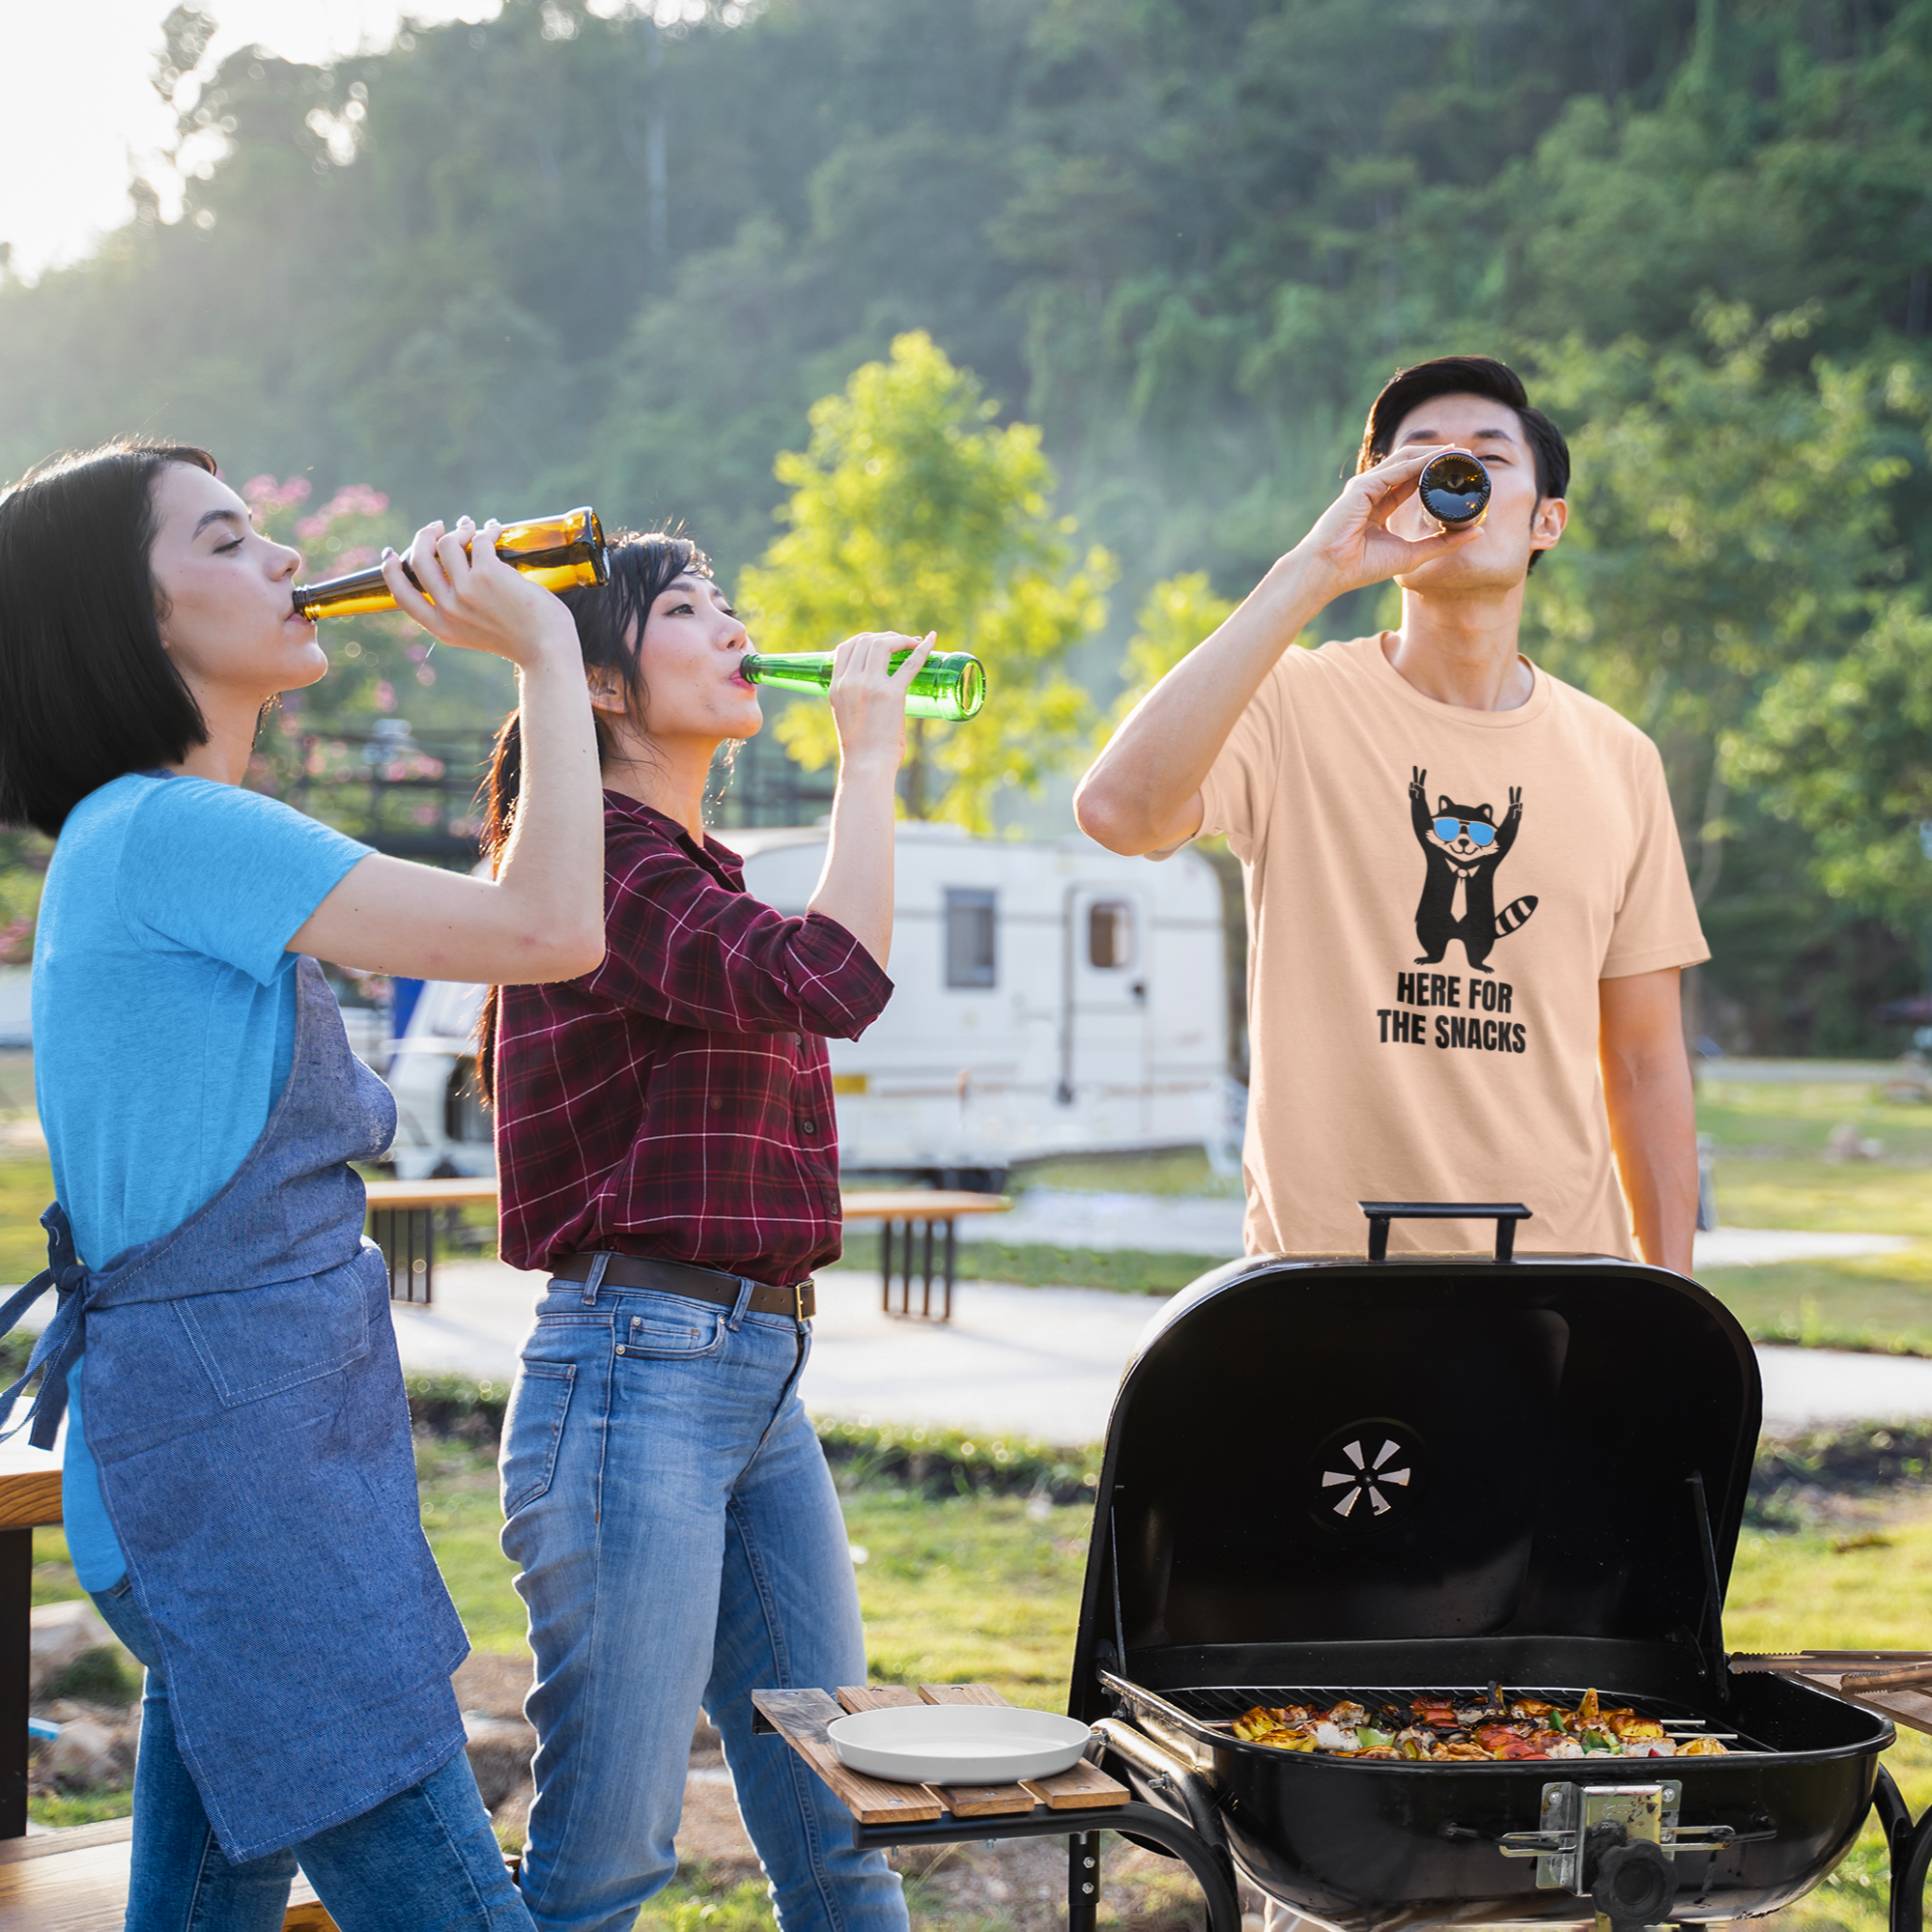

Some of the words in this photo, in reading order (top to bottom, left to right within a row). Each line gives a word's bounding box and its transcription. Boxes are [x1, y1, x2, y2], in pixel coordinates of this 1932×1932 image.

[1397, 972, 1461, 1008] HERE
[1468, 979, 1513, 1013] FOR
[1377, 1009, 1427, 1045] THE
[1435, 1014, 1526, 1054] SNACKS
